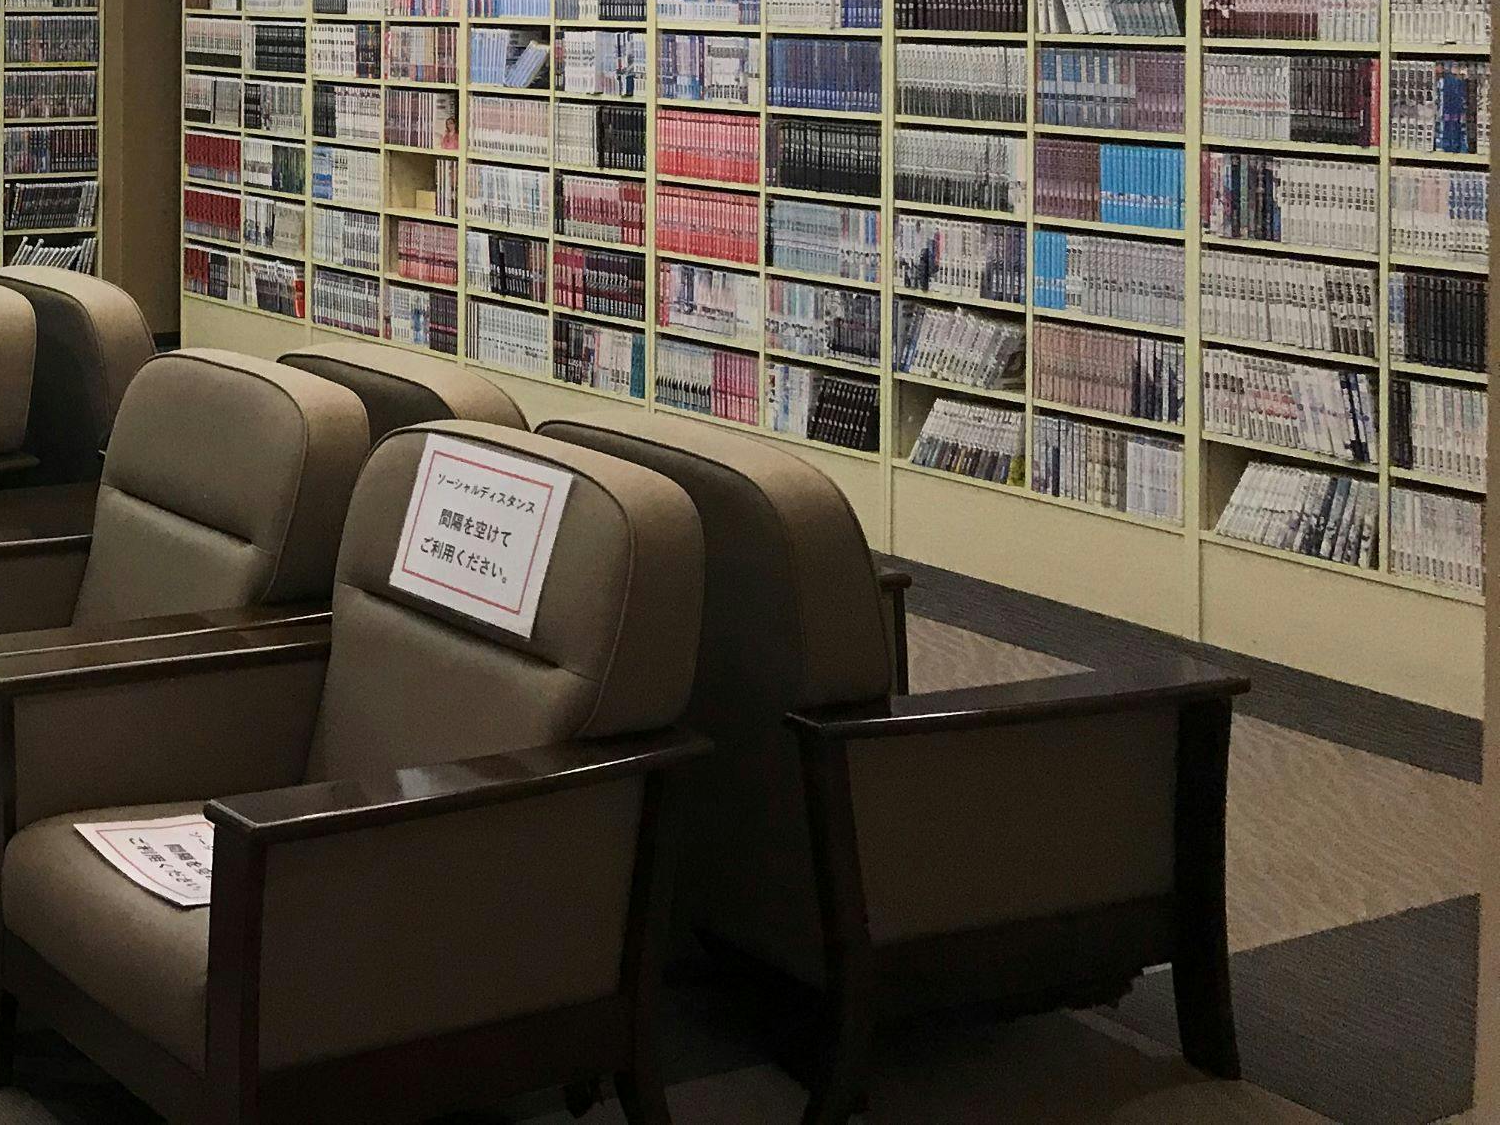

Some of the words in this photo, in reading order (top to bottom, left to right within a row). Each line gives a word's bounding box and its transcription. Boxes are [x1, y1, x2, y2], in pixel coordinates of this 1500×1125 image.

[437, 473, 535, 515] ソーシャルディスタンス
[438, 508, 513, 548] 間隔を空けて
[420, 536, 508, 584] ご利用ください。
